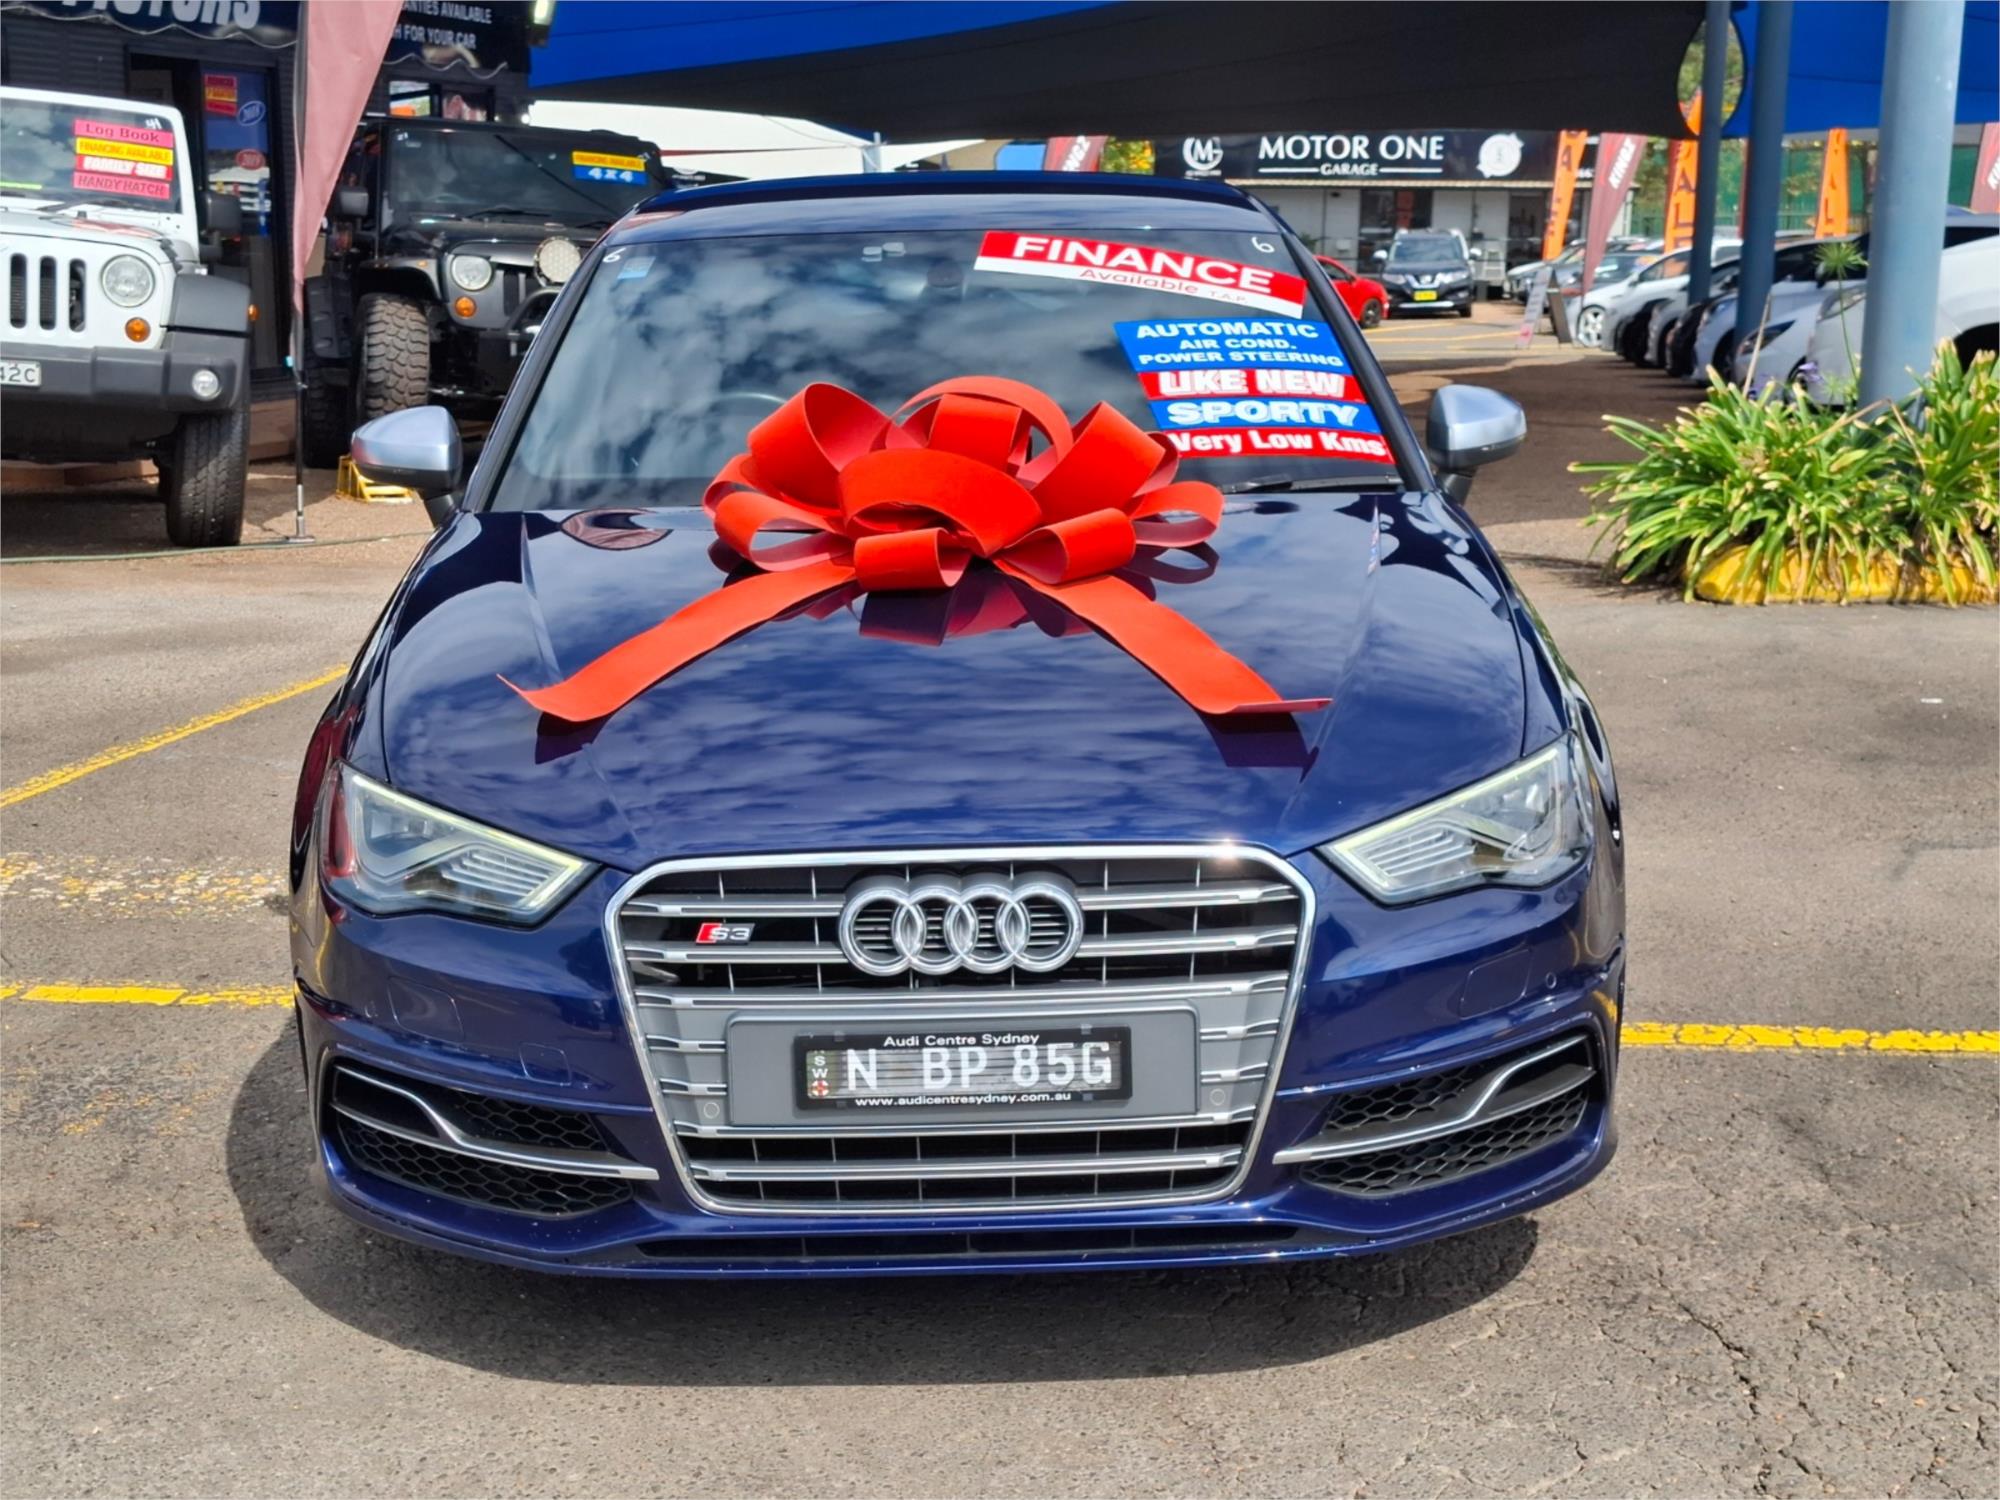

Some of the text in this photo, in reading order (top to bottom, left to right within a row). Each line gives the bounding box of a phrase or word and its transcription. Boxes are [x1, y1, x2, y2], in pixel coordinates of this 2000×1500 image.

[62, 0, 261, 29] ORS
[441, 2, 492, 24] AVAILABLE
[404, 25, 425, 42] FOR
[427, 28, 454, 46] YOUR
[456, 32, 476, 49] CAR
[86, 124, 159, 142] Log Book
[1258, 135, 1445, 160] MOTOR ONE
[1320, 163, 1379, 175] GARAGE
[78, 175, 164, 195] HANDY HATCH
[603, 247, 626, 263] 6
[1012, 237, 1274, 294] FINANCE
[1080, 269, 1199, 294] Available
[1137, 322, 1319, 338] AUTOMATIC
[1180, 339, 1296, 350] AIR COND.
[1139, 351, 1344, 367] POWER STEERING
[1157, 369, 1345, 397] LIKE NEW
[1167, 400, 1360, 427] SPORTY
[1168, 430, 1387, 456] Very Low Kms
[708, 927, 751, 941] S3
[883, 1033, 1040, 1047] Audi Centre Sydney
[1012, 1042, 1112, 1088] 85G
[855, 1092, 1072, 1106] www.audicentresydney.com.au
